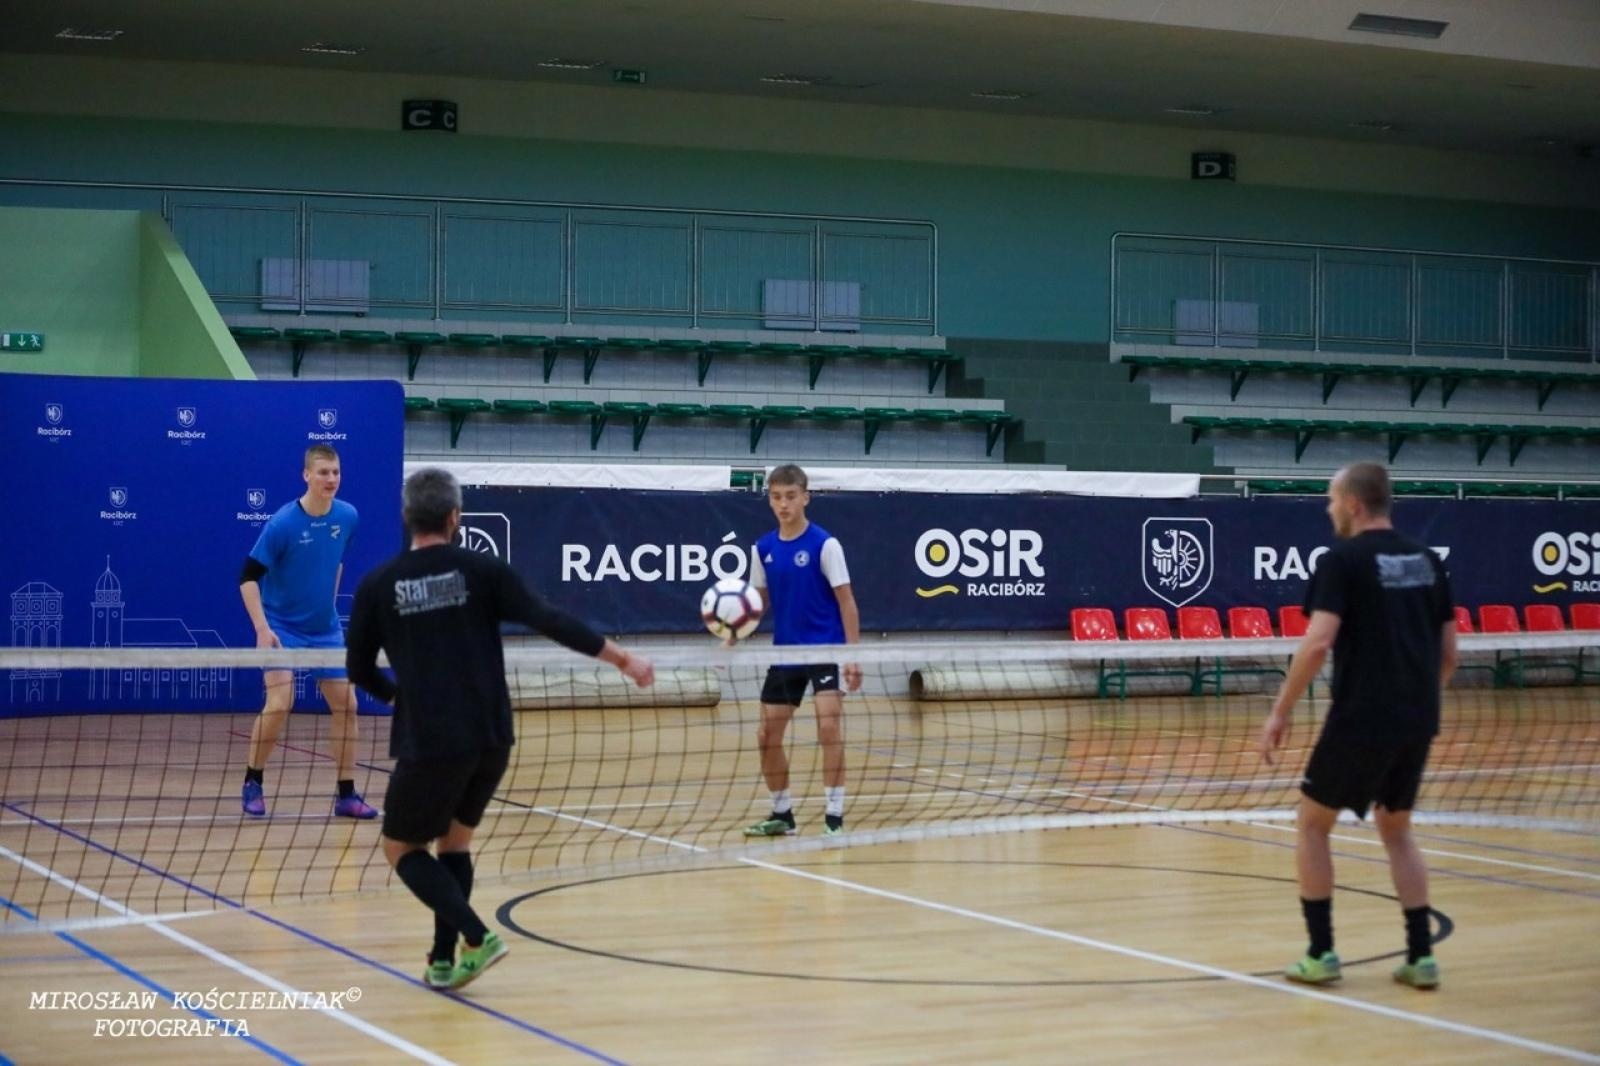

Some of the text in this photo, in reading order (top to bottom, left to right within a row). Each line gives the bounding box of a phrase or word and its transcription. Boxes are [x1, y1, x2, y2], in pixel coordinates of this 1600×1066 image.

[409, 110, 431, 126] C
[1199, 161, 1222, 176] D
[37, 427, 72, 436] Racibórz
[168, 430, 206, 439] Racibórz
[308, 432, 347, 440] Racibórz
[100, 511, 137, 520] Racibórz
[237, 512, 273, 520] Racibór
[561, 531, 750, 582] RACIBÓ
[914, 528, 1046, 578] OSiR
[1532, 531, 1600, 576] OSi
[967, 579, 1046, 597] RACIBÓRZ
